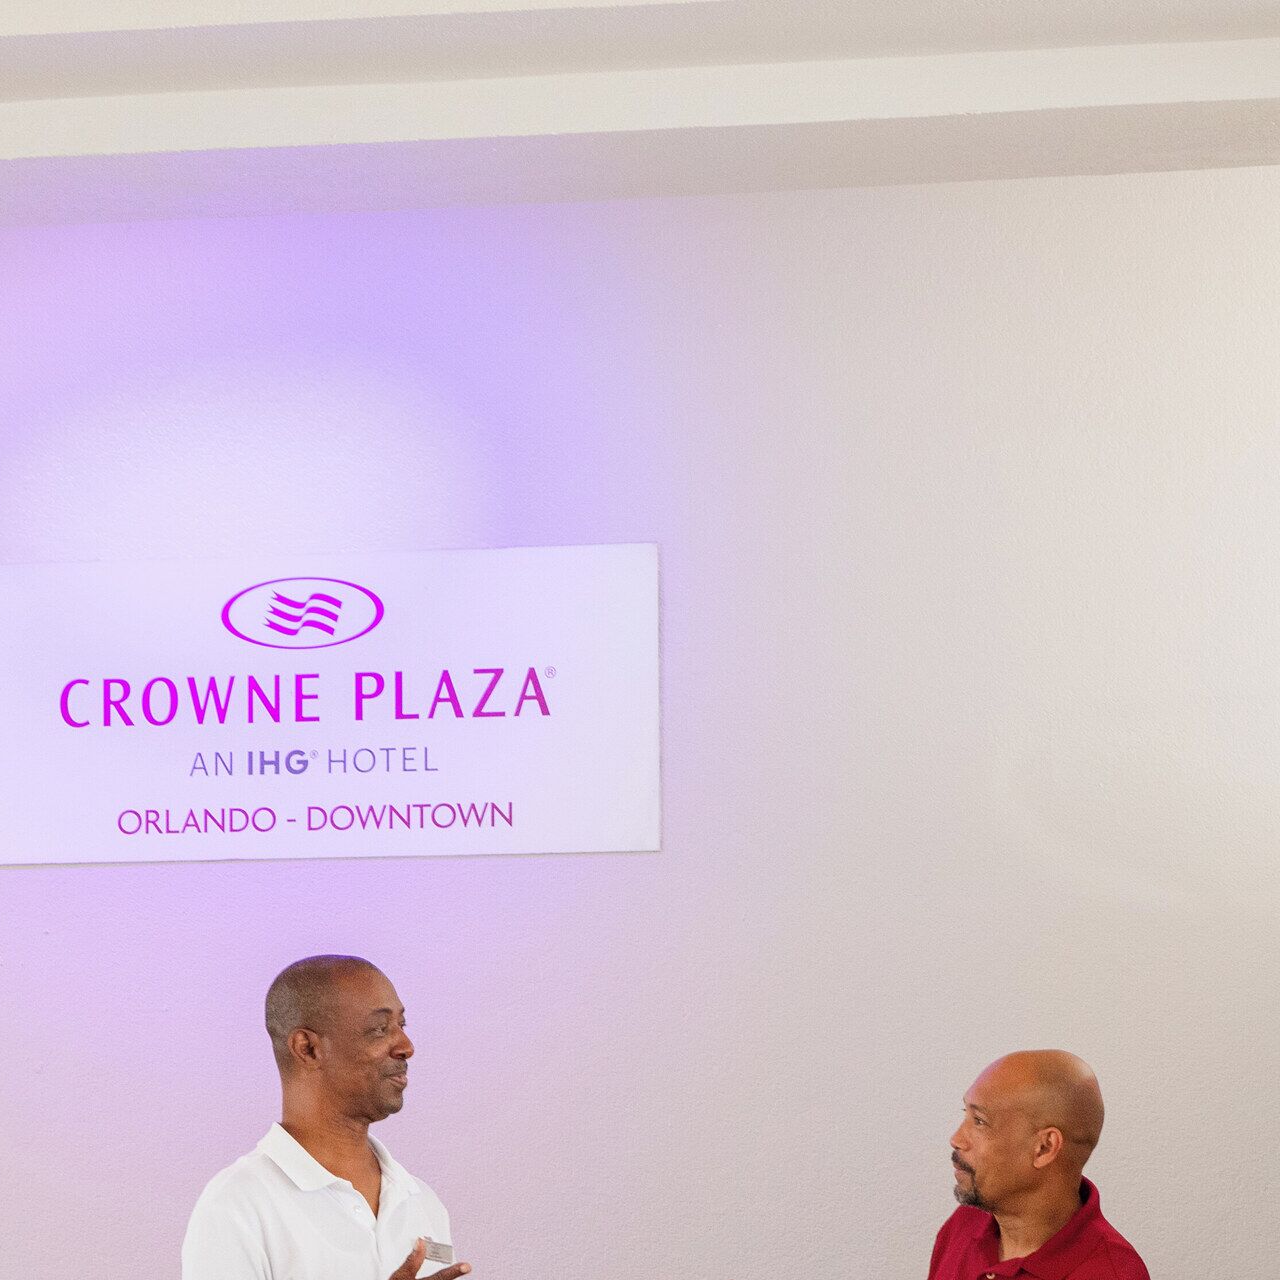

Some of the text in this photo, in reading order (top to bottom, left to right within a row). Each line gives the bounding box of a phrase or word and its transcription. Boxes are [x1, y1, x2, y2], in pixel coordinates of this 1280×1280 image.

[59, 673, 320, 728] CROWNE
[189, 750, 233, 777] AN
[327, 746, 439, 774] HOTEL
[116, 806, 277, 835] ORLANDO
[306, 801, 513, 831] DOWNTOWN
